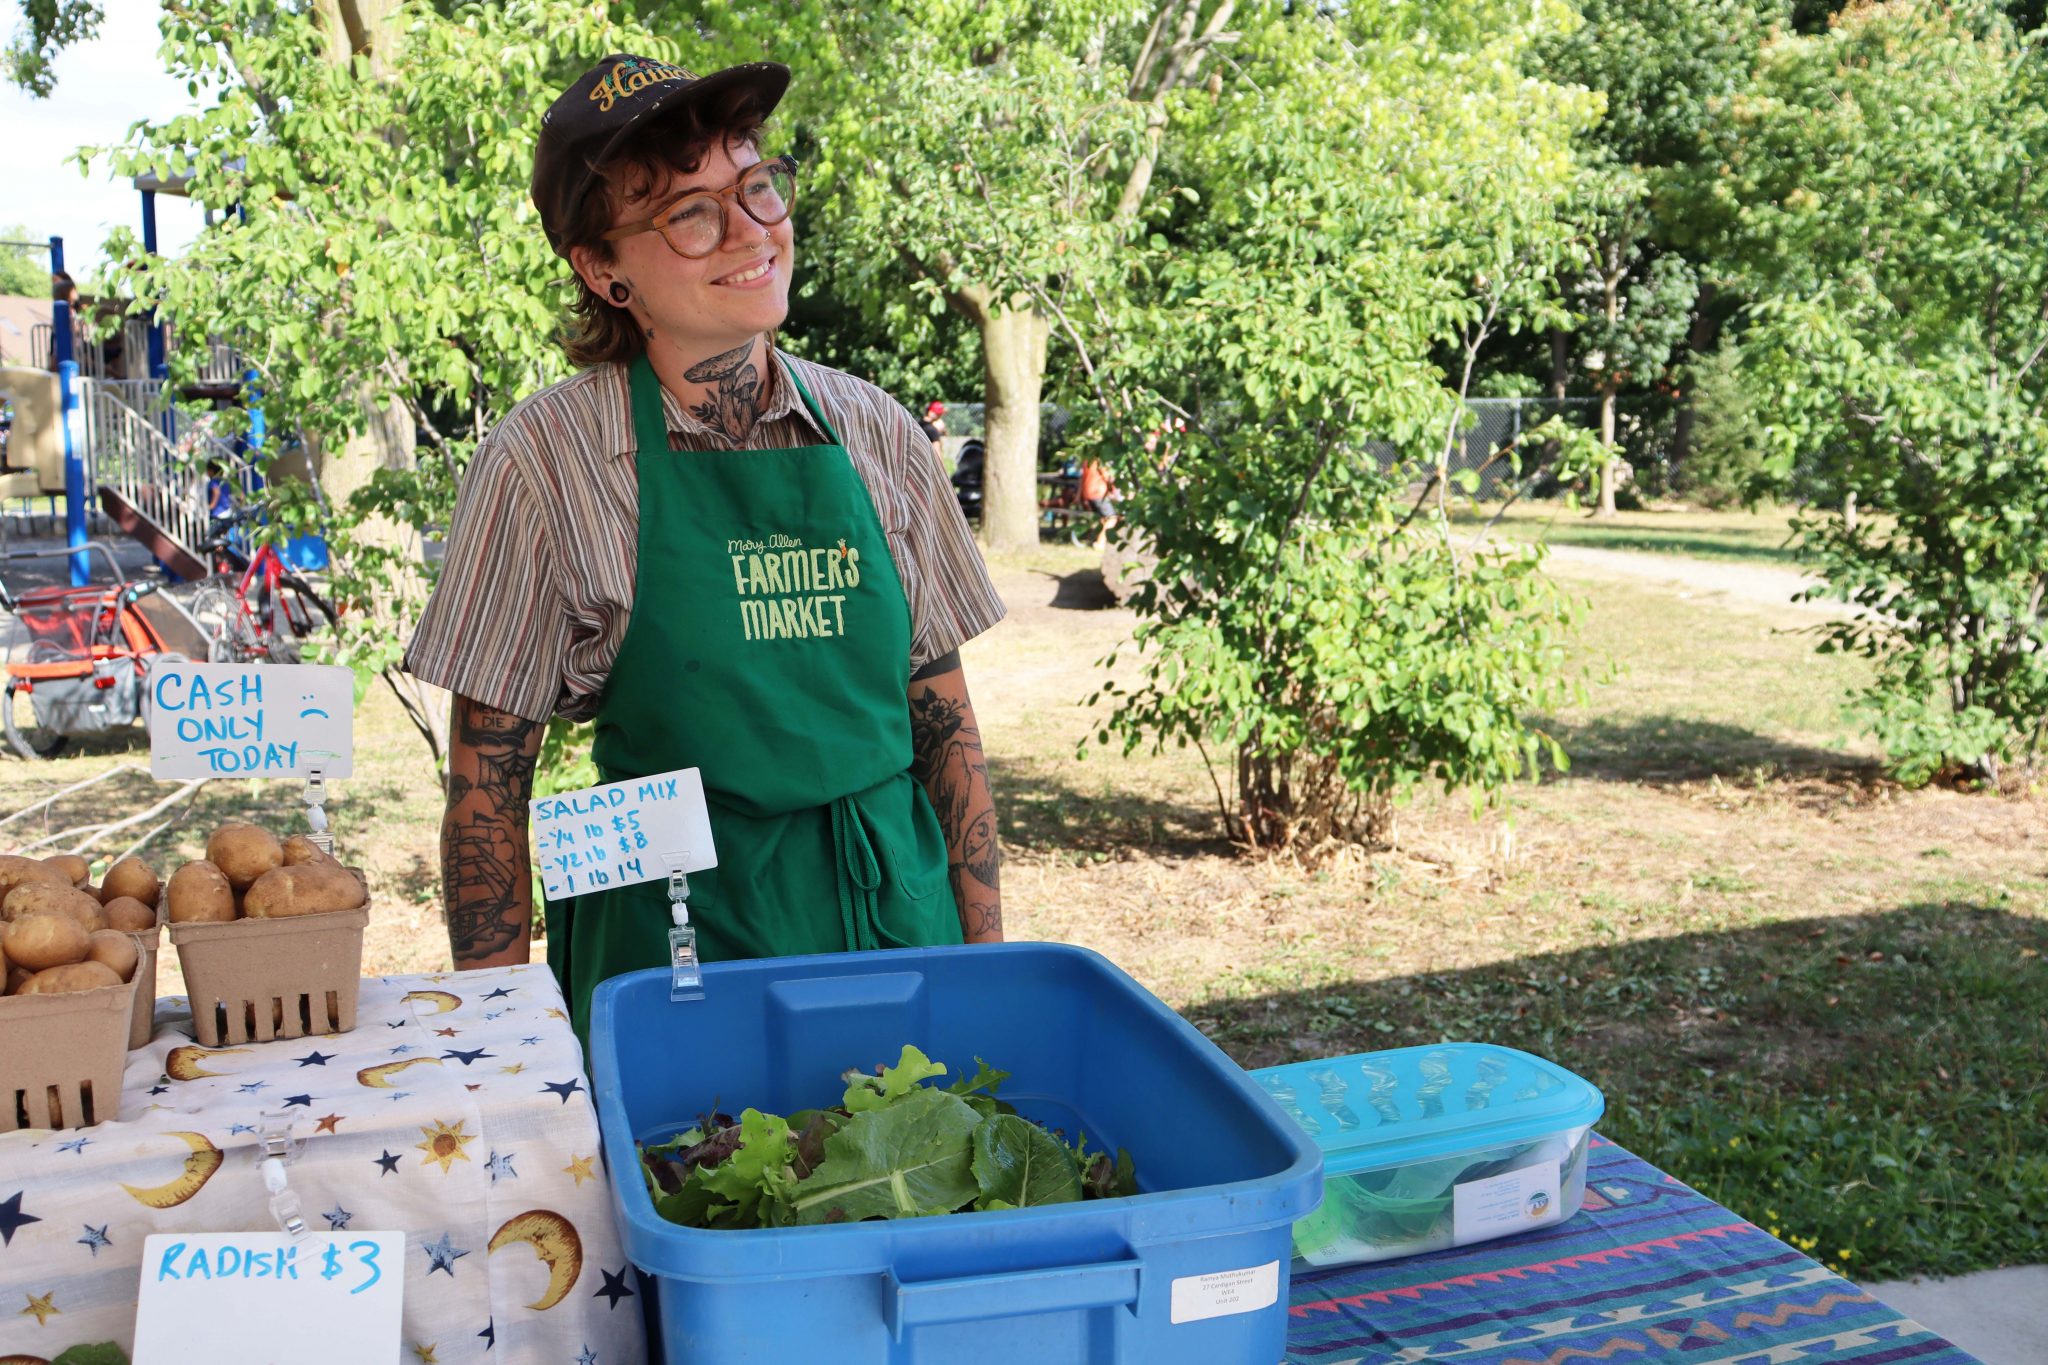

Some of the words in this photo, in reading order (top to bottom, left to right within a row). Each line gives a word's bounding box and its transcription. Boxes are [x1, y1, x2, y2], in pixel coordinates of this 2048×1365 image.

[728, 539, 766, 554] Mary
[769, 534, 802, 548] Allen
[740, 595, 846, 640] MARKET
[156, 673, 263, 711] CASH
[177, 709, 263, 742] ONLY
[482, 716, 506, 728] DIE
[197, 741, 298, 772] TODAY
[536, 788, 625, 821] SALAD
[638, 778, 678, 802] MIX
[611, 810, 641, 833] $5
[618, 831, 648, 854] $8
[617, 857, 644, 882] 14
[158, 1242, 298, 1281] RADISH
[321, 1240, 381, 1294] $3
[1236, 1277, 1253, 1286] Street
